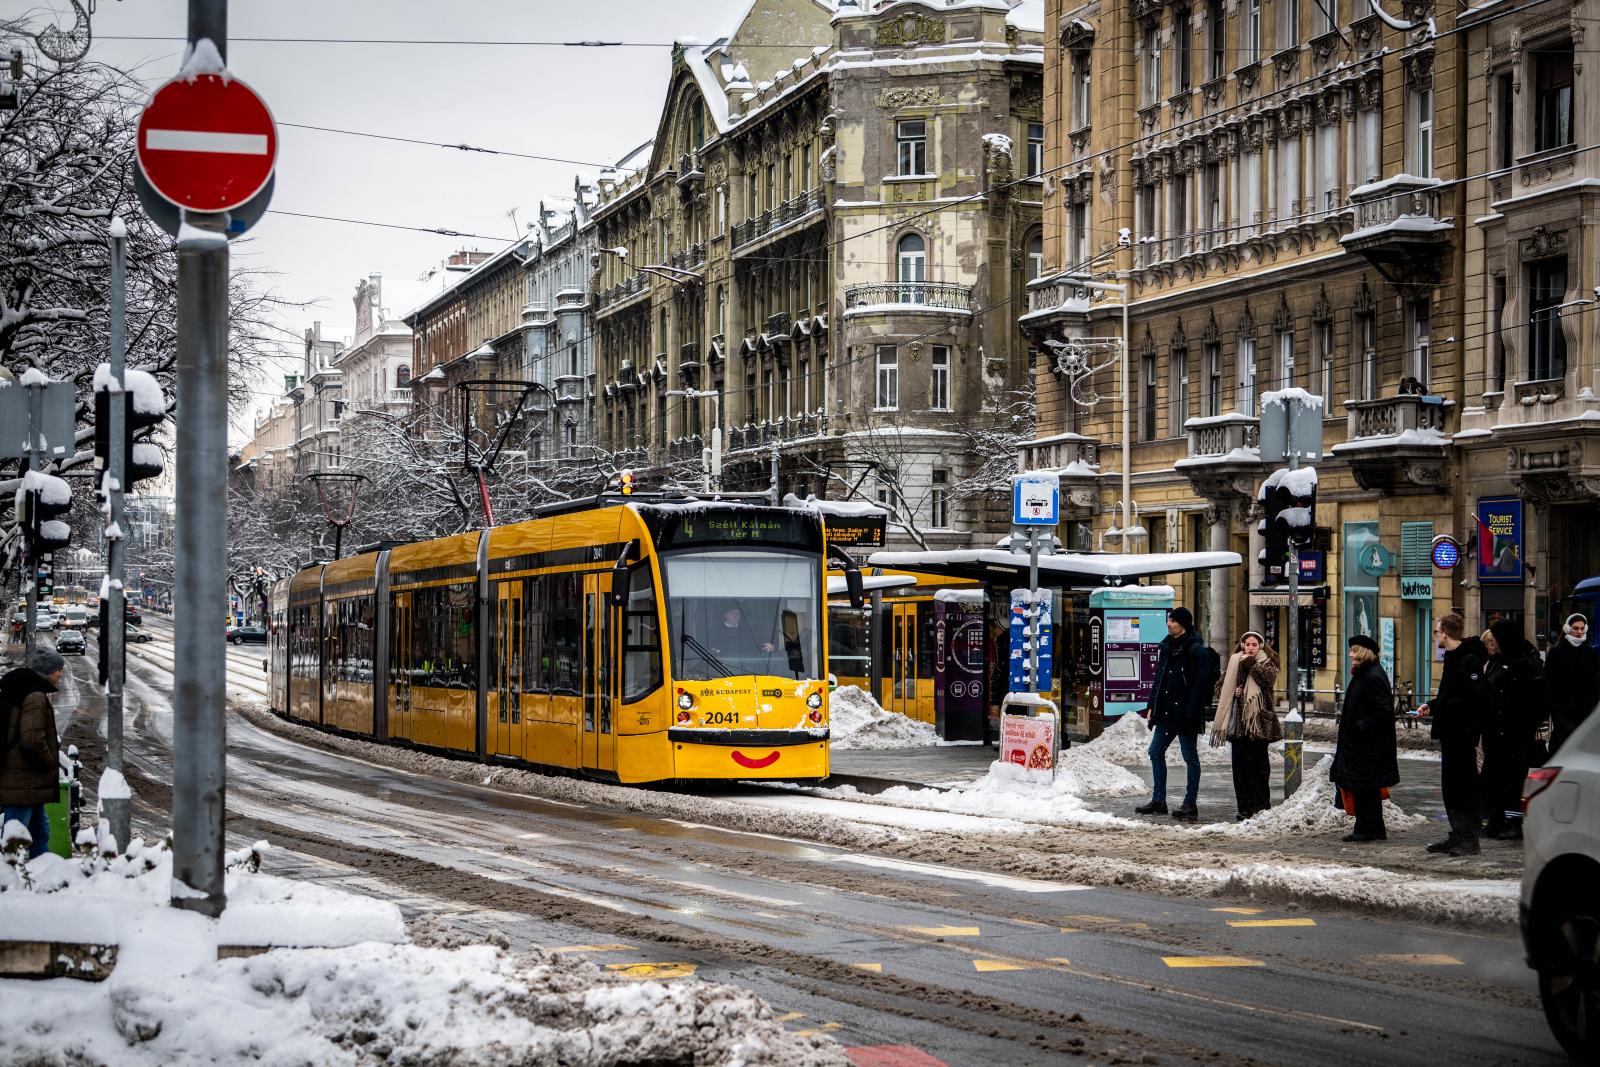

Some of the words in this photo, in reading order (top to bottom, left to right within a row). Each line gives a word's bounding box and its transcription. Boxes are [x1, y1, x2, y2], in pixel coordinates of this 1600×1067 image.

[1488, 514, 1513, 523] TOURIST
[684, 518, 694, 538] 4
[708, 520, 738, 529] Széll
[741, 520, 781, 529] Kálmán
[731, 530, 748, 538] tér
[751, 530, 760, 538] M
[1488, 526, 1513, 535] SERVICE
[705, 712, 740, 724] 2041
